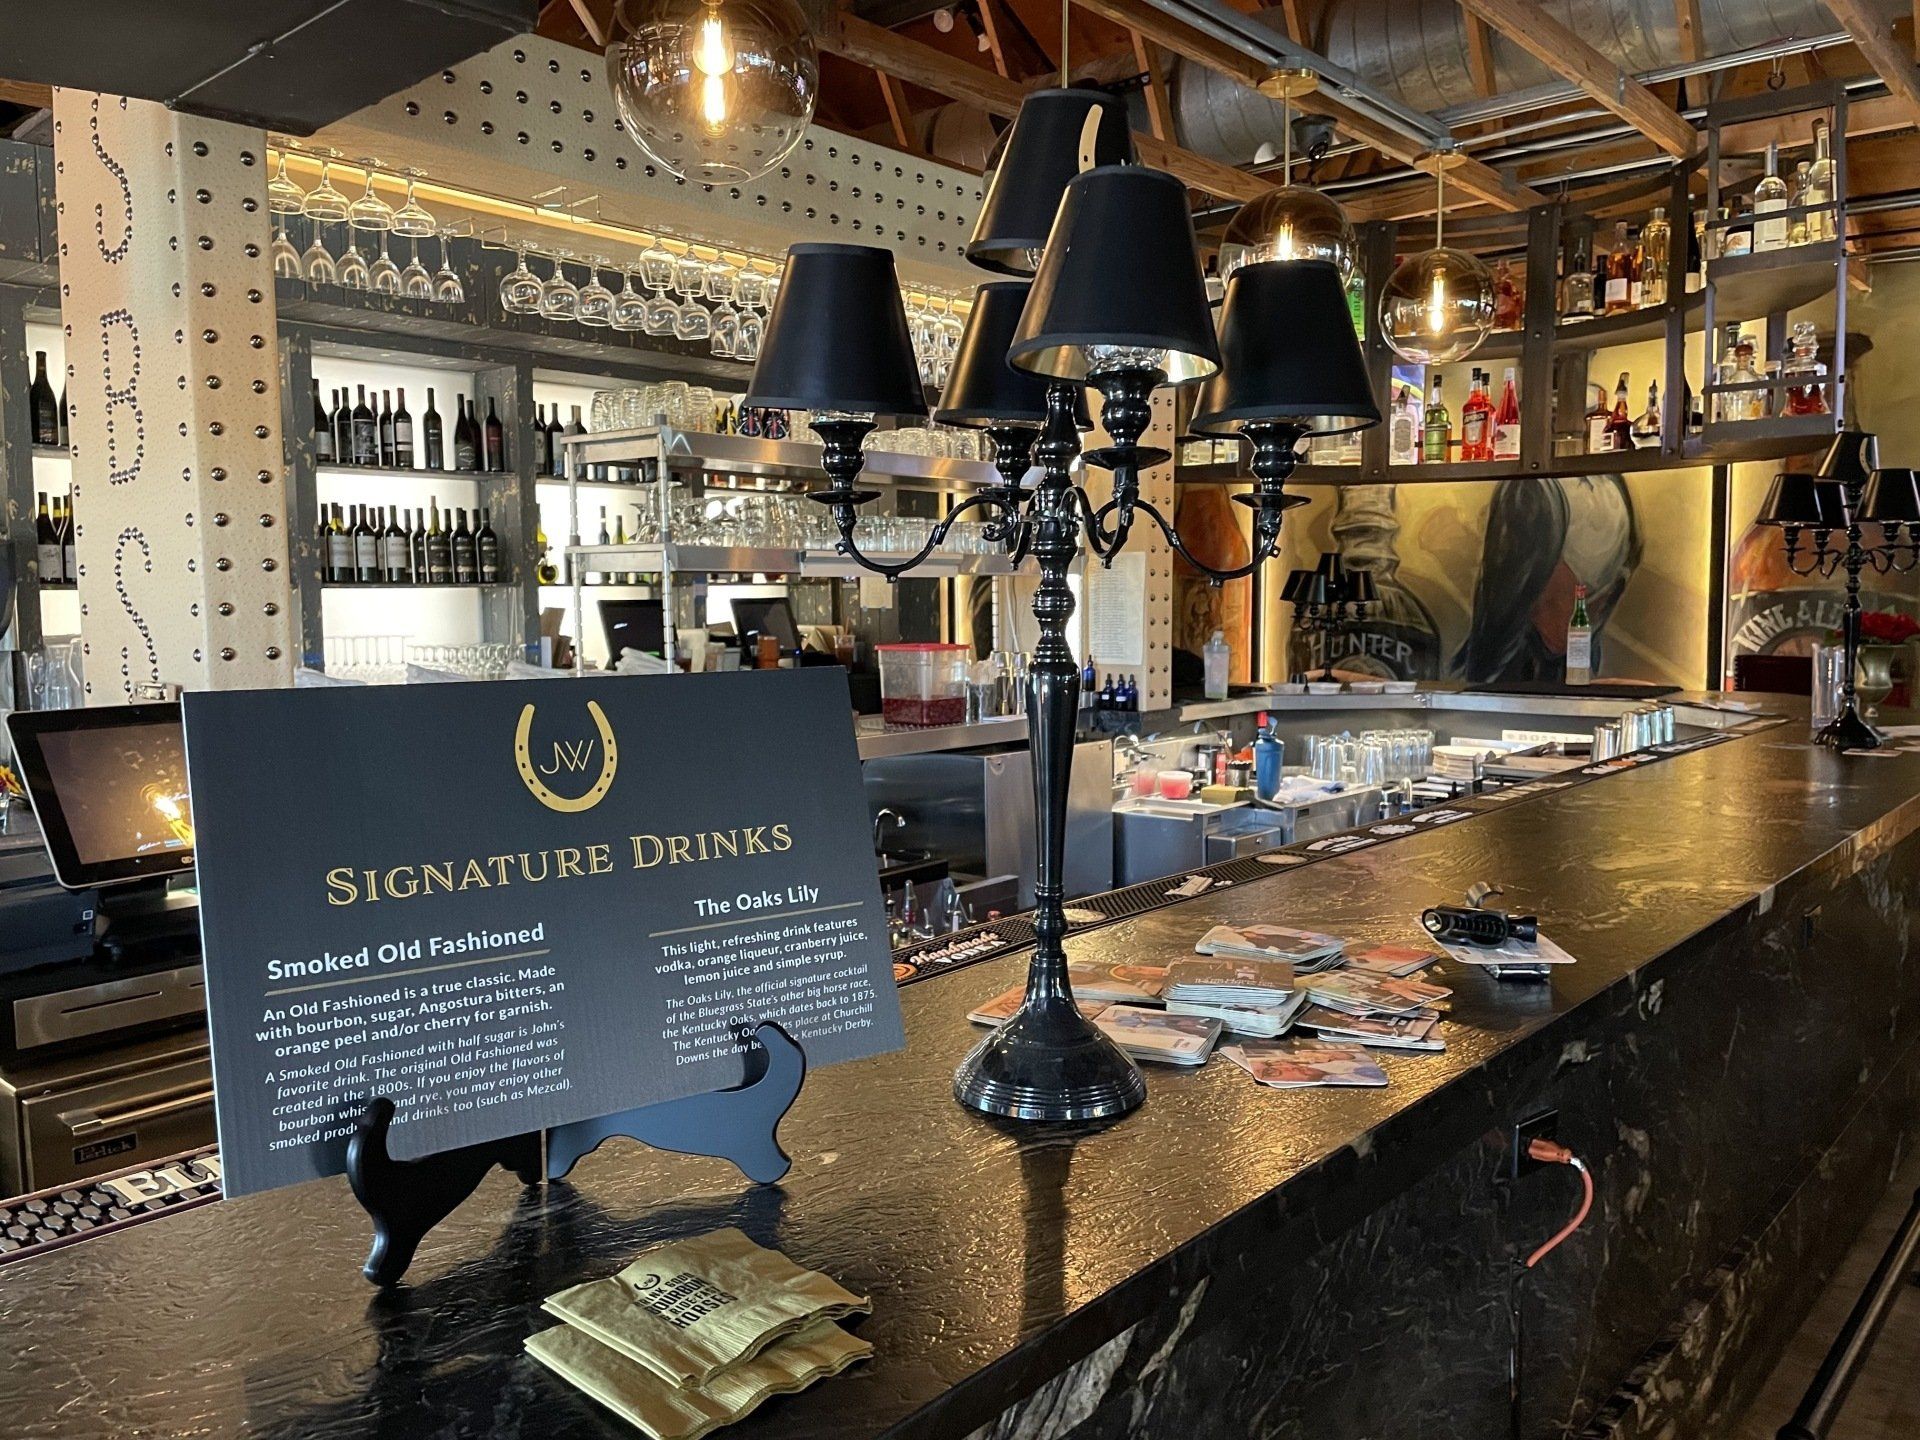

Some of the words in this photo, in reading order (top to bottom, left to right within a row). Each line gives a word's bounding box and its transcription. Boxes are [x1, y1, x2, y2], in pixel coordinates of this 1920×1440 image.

[1302, 629, 1417, 675] HUNTER
[539, 739, 594, 775] JW
[693, 898, 731, 917] The
[736, 890, 783, 911] Oaks
[787, 884, 819, 904] Lily
[267, 946, 370, 980] Smoked
[377, 939, 422, 964] Old
[429, 922, 545, 957] Fashioned
[654, 960, 695, 974] vodka,
[697, 953, 738, 967] orange
[739, 945, 782, 961] liqueur,
[784, 936, 837, 953] cranberry
[838, 931, 868, 946] juice,
[661, 943, 687, 957] This
[689, 939, 720, 954] light,
[722, 930, 781, 948] refreshing
[782, 924, 812, 938] drink
[813, 918, 858, 933] features
[665, 998, 685, 1009] The
[687, 992, 713, 1006] Oaks
[714, 989, 735, 1001] Lily,
[736, 986, 753, 997] the
[754, 978, 787, 993] official
[789, 972, 832, 988] signature
[833, 963, 868, 979] cocktail
[683, 971, 721, 986] lemon
[722, 966, 751, 981] juice
[752, 960, 774, 974] and
[775, 954, 812, 970] simple
[813, 950, 847, 964] syrup.
[255, 1024, 292, 1042] with
[297, 1015, 367, 1035] bourbon,
[370, 1007, 415, 1022] sugar,
[418, 994, 493, 1015] Angostura
[495, 984, 546, 1002] bitters,
[548, 981, 565, 993] an
[263, 1009, 286, 1023] An
[289, 1001, 318, 1018] Old
[322, 988, 400, 1013] Fashioned
[404, 987, 417, 1000] is
[420, 987, 429, 997] a
[432, 981, 462, 995] true
[465, 972, 516, 989] classic.
[518, 965, 556, 981] Made
[661, 1029, 680, 1040] the
[681, 1019, 728, 1036] Kentucky
[729, 1013, 757, 1026] Oaks,
[758, 1006, 787, 1021] which
[788, 1003, 814, 1014] dates
[815, 996, 838, 1009] back
[839, 995, 849, 1005] to
[851, 989, 878, 1002] 1875.
[665, 1012, 677, 1025] of
[679, 1010, 696, 1022] the
[698, 1002, 745, 1018] Bluegrass
[746, 994, 778, 1009] State's
[780, 990, 805, 1003] other
[806, 986, 821, 998] big
[822, 982, 848, 994] horse
[849, 978, 871, 989] race,
[264, 1072, 275, 1084] A
[279, 1061, 330, 1082] Smoked
[334, 1056, 357, 1071] Old
[361, 1044, 424, 1066] Fashioned
[428, 1039, 455, 1054] with
[458, 1034, 481, 1048] half
[484, 1029, 516, 1044] sugar
[518, 1026, 528, 1037] is
[530, 1019, 565, 1036] John's
[274, 1039, 330, 1057] orange
[334, 1030, 367, 1049] peel
[371, 1023, 420, 1041] and/or
[424, 1014, 471, 1031] cherry
[474, 1010, 496, 1023] for
[499, 999, 553, 1021] garnish.
[672, 1040, 692, 1052] The
[693, 1031, 740, 1047] Kentucky
[795, 1015, 819, 1028] place
[821, 1012, 831, 1021] at
[833, 1003, 873, 1019] Churchill
[676, 1051, 710, 1066] Downs
[712, 1047, 729, 1058] the
[731, 1043, 749, 1054] day
[801, 1023, 843, 1040] Kentucky
[844, 1018, 874, 1031] Derby.
[272, 1096, 323, 1116] created
[327, 1094, 339, 1106] in
[343, 1089, 365, 1102] the
[369, 1080, 413, 1098] 1800s.
[417, 1076, 426, 1089] If
[428, 1073, 451, 1087] you
[454, 1066, 487, 1081] enjoy
[489, 1061, 509, 1074] the
[512, 1054, 551, 1071] flavors
[553, 1048, 565, 1061] of
[277, 1080, 329, 1100] favorite
[333, 1072, 370, 1088] drink.
[374, 1067, 397, 1080] The
[400, 1056, 447, 1075] original
[450, 1050, 472, 1065] Old
[475, 1040, 533, 1060] Fashioned
[536, 1037, 558, 1048] was
[269, 1130, 320, 1151] smoked
[389, 1112, 409, 1126] nd
[412, 1105, 449, 1121] drinks
[453, 1100, 473, 1112] too
[476, 1093, 508, 1109] (such
[510, 1090, 524, 1101] as
[527, 1077, 573, 1097] Mezcal).
[279, 1112, 335, 1132] bourbon
[420, 1093, 443, 1105] rye,
[446, 1087, 468, 1100] you
[471, 1080, 496, 1094] may
[498, 1073, 530, 1089] enjoy
[532, 1066, 563, 1081] other
[670, 1291, 738, 1329] HORSES
